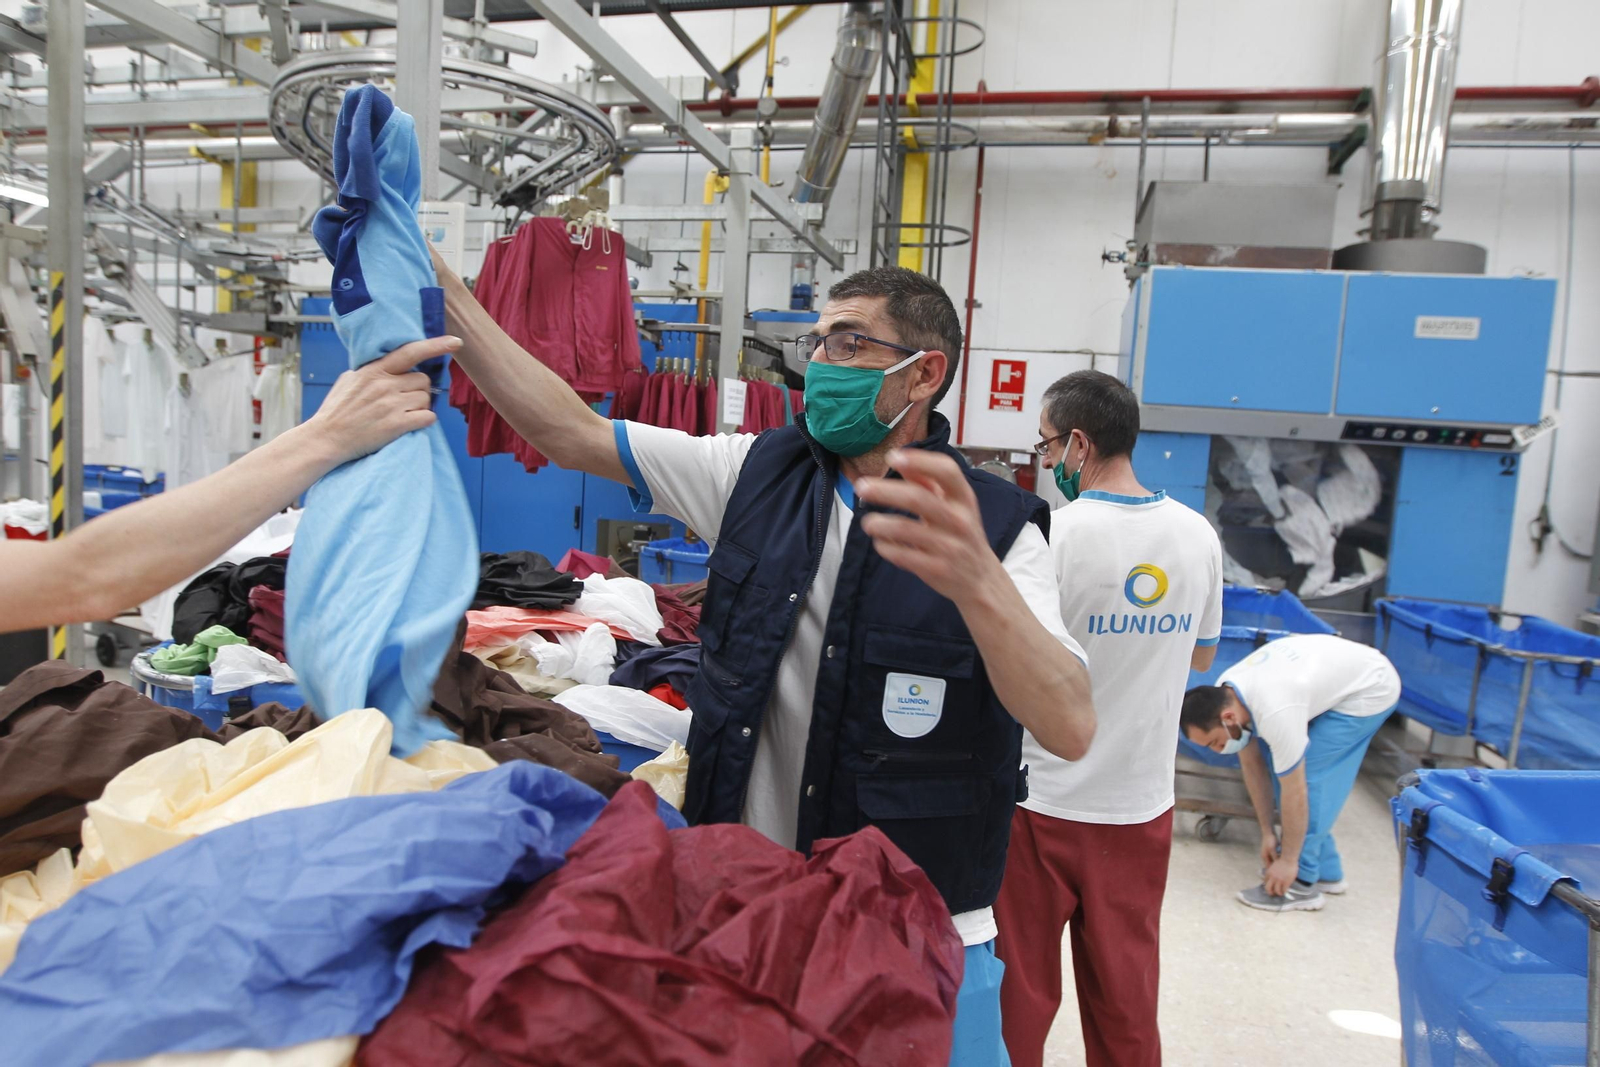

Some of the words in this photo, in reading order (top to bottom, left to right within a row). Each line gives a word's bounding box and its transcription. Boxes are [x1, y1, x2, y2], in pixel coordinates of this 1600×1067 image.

[1499, 455, 1516, 476] 2
[1088, 613, 1192, 635] ILUNION
[897, 697, 930, 705] ILUNION
